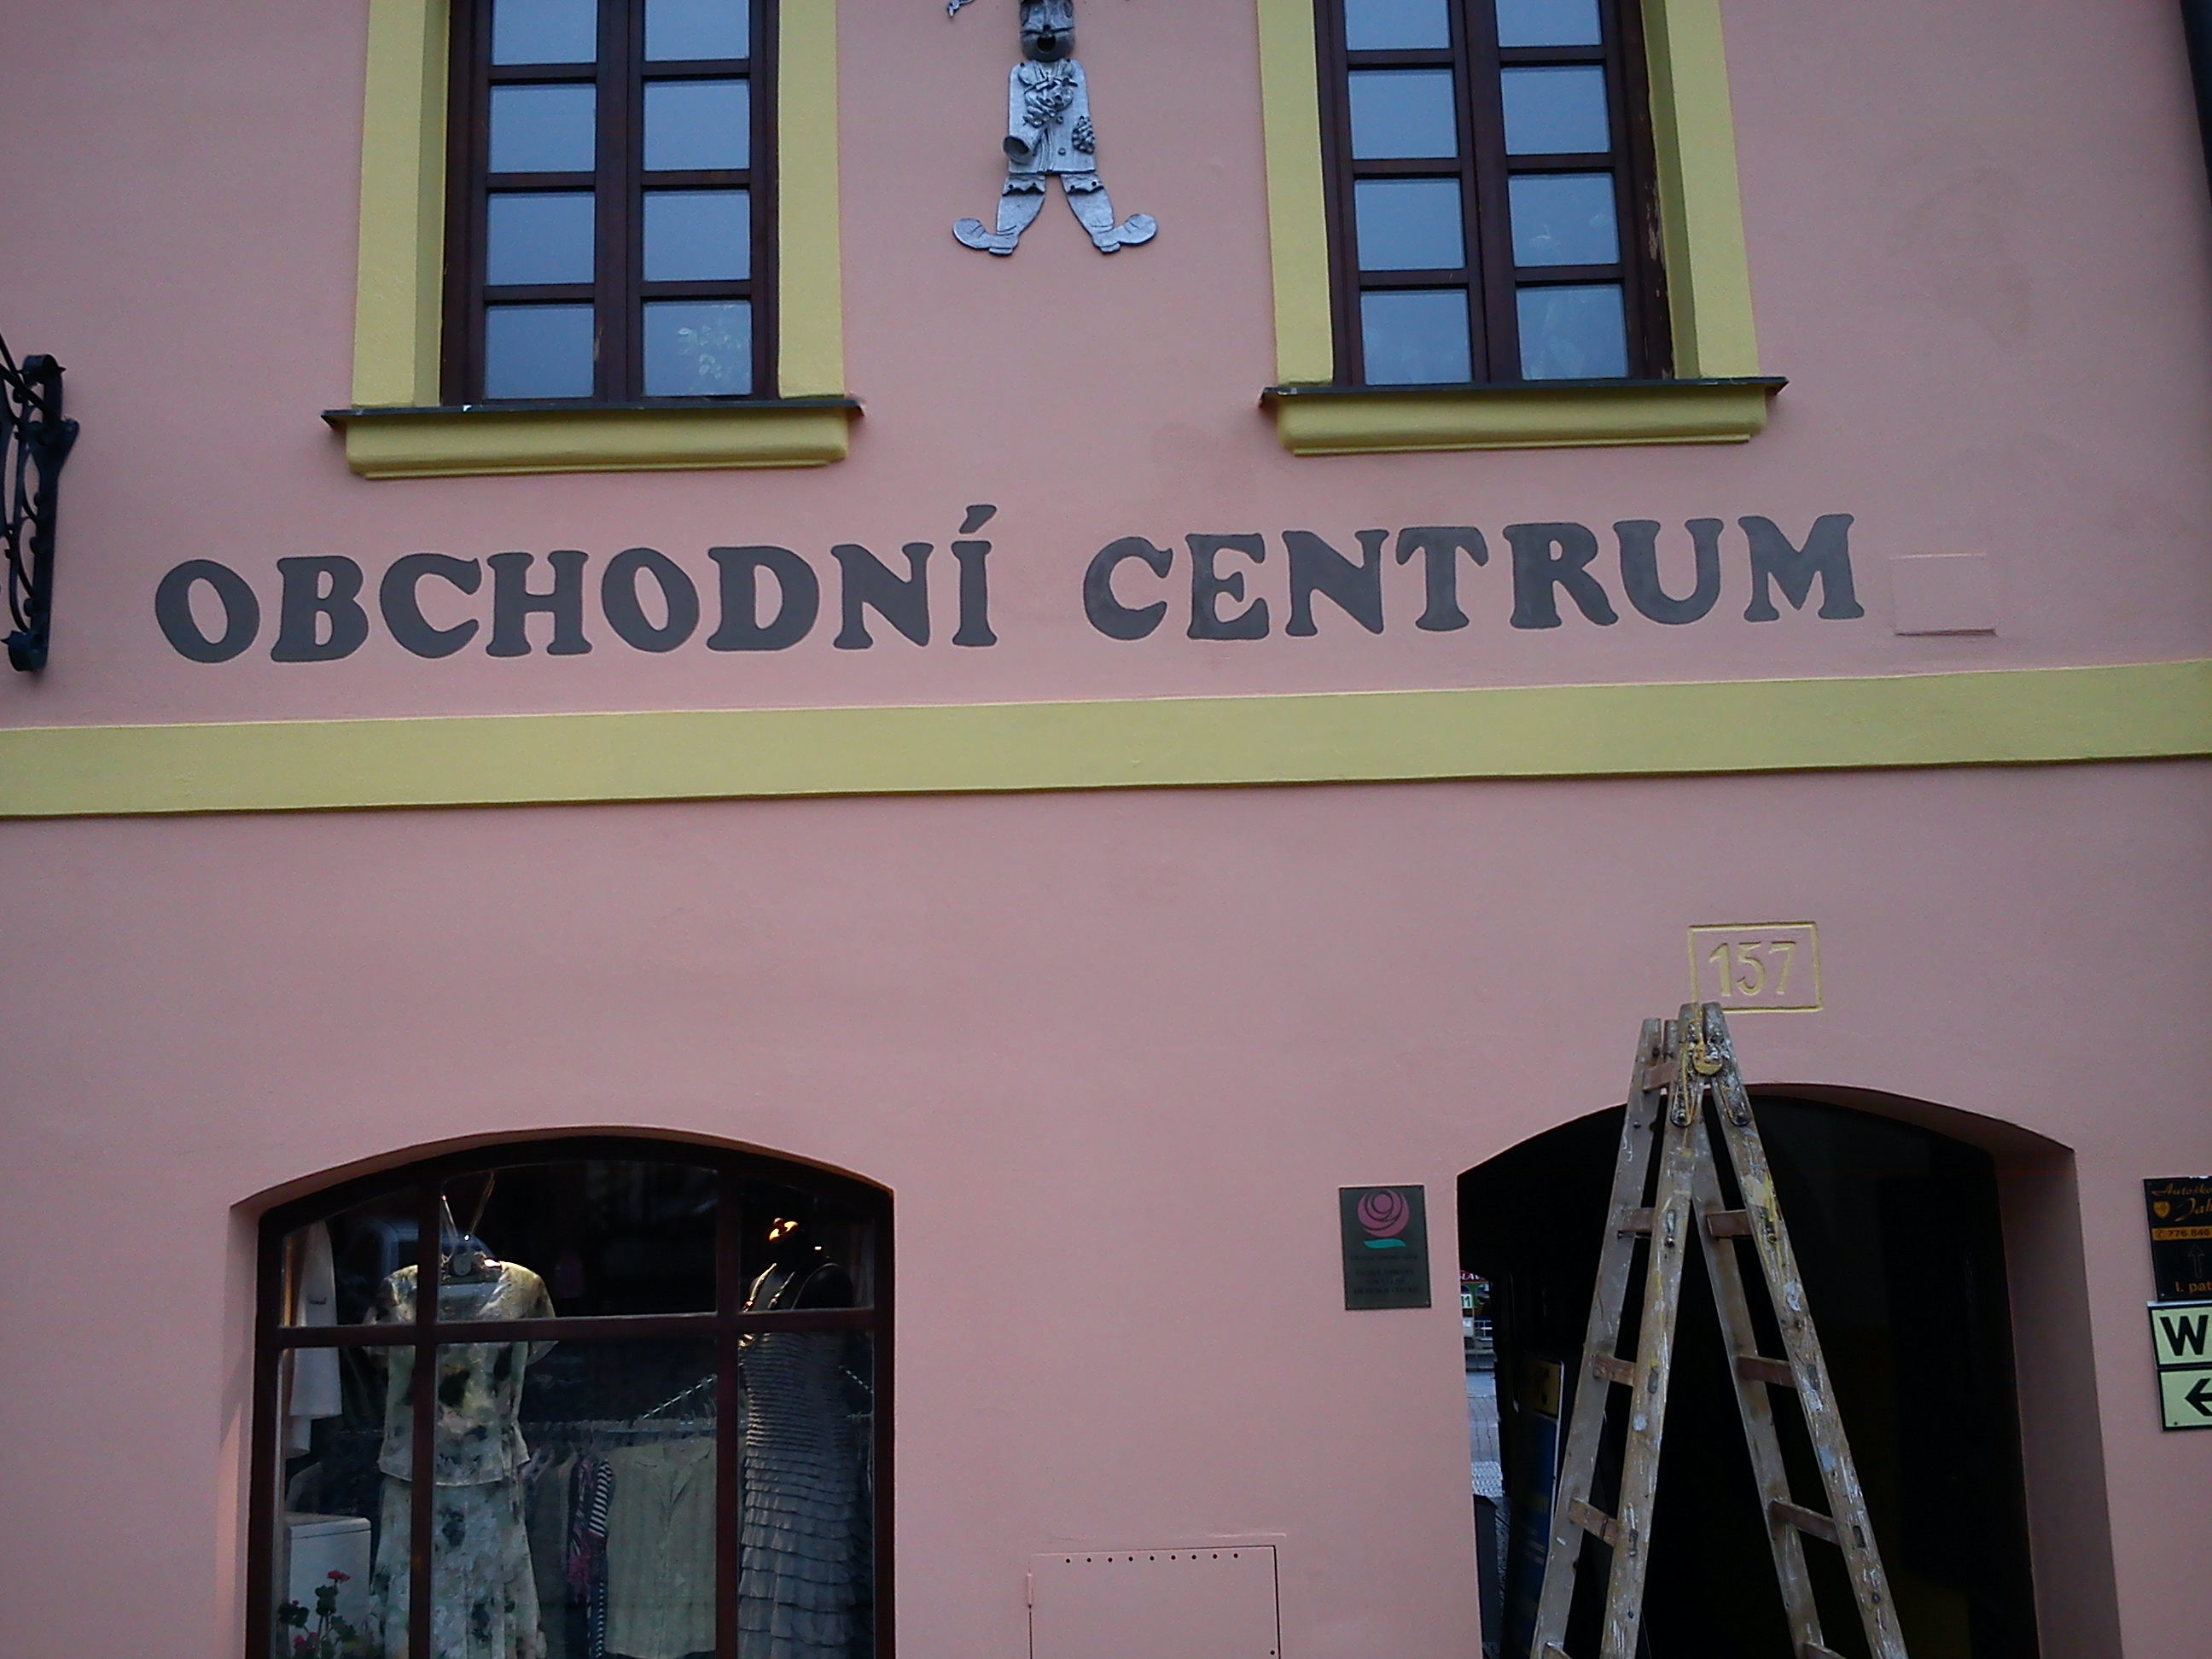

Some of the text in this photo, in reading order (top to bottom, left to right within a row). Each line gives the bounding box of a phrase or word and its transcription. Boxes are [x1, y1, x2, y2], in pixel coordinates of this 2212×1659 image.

[154, 504, 1865, 664] OBCHODNÍ CENTRUM
[1709, 940, 1796, 997] 157
